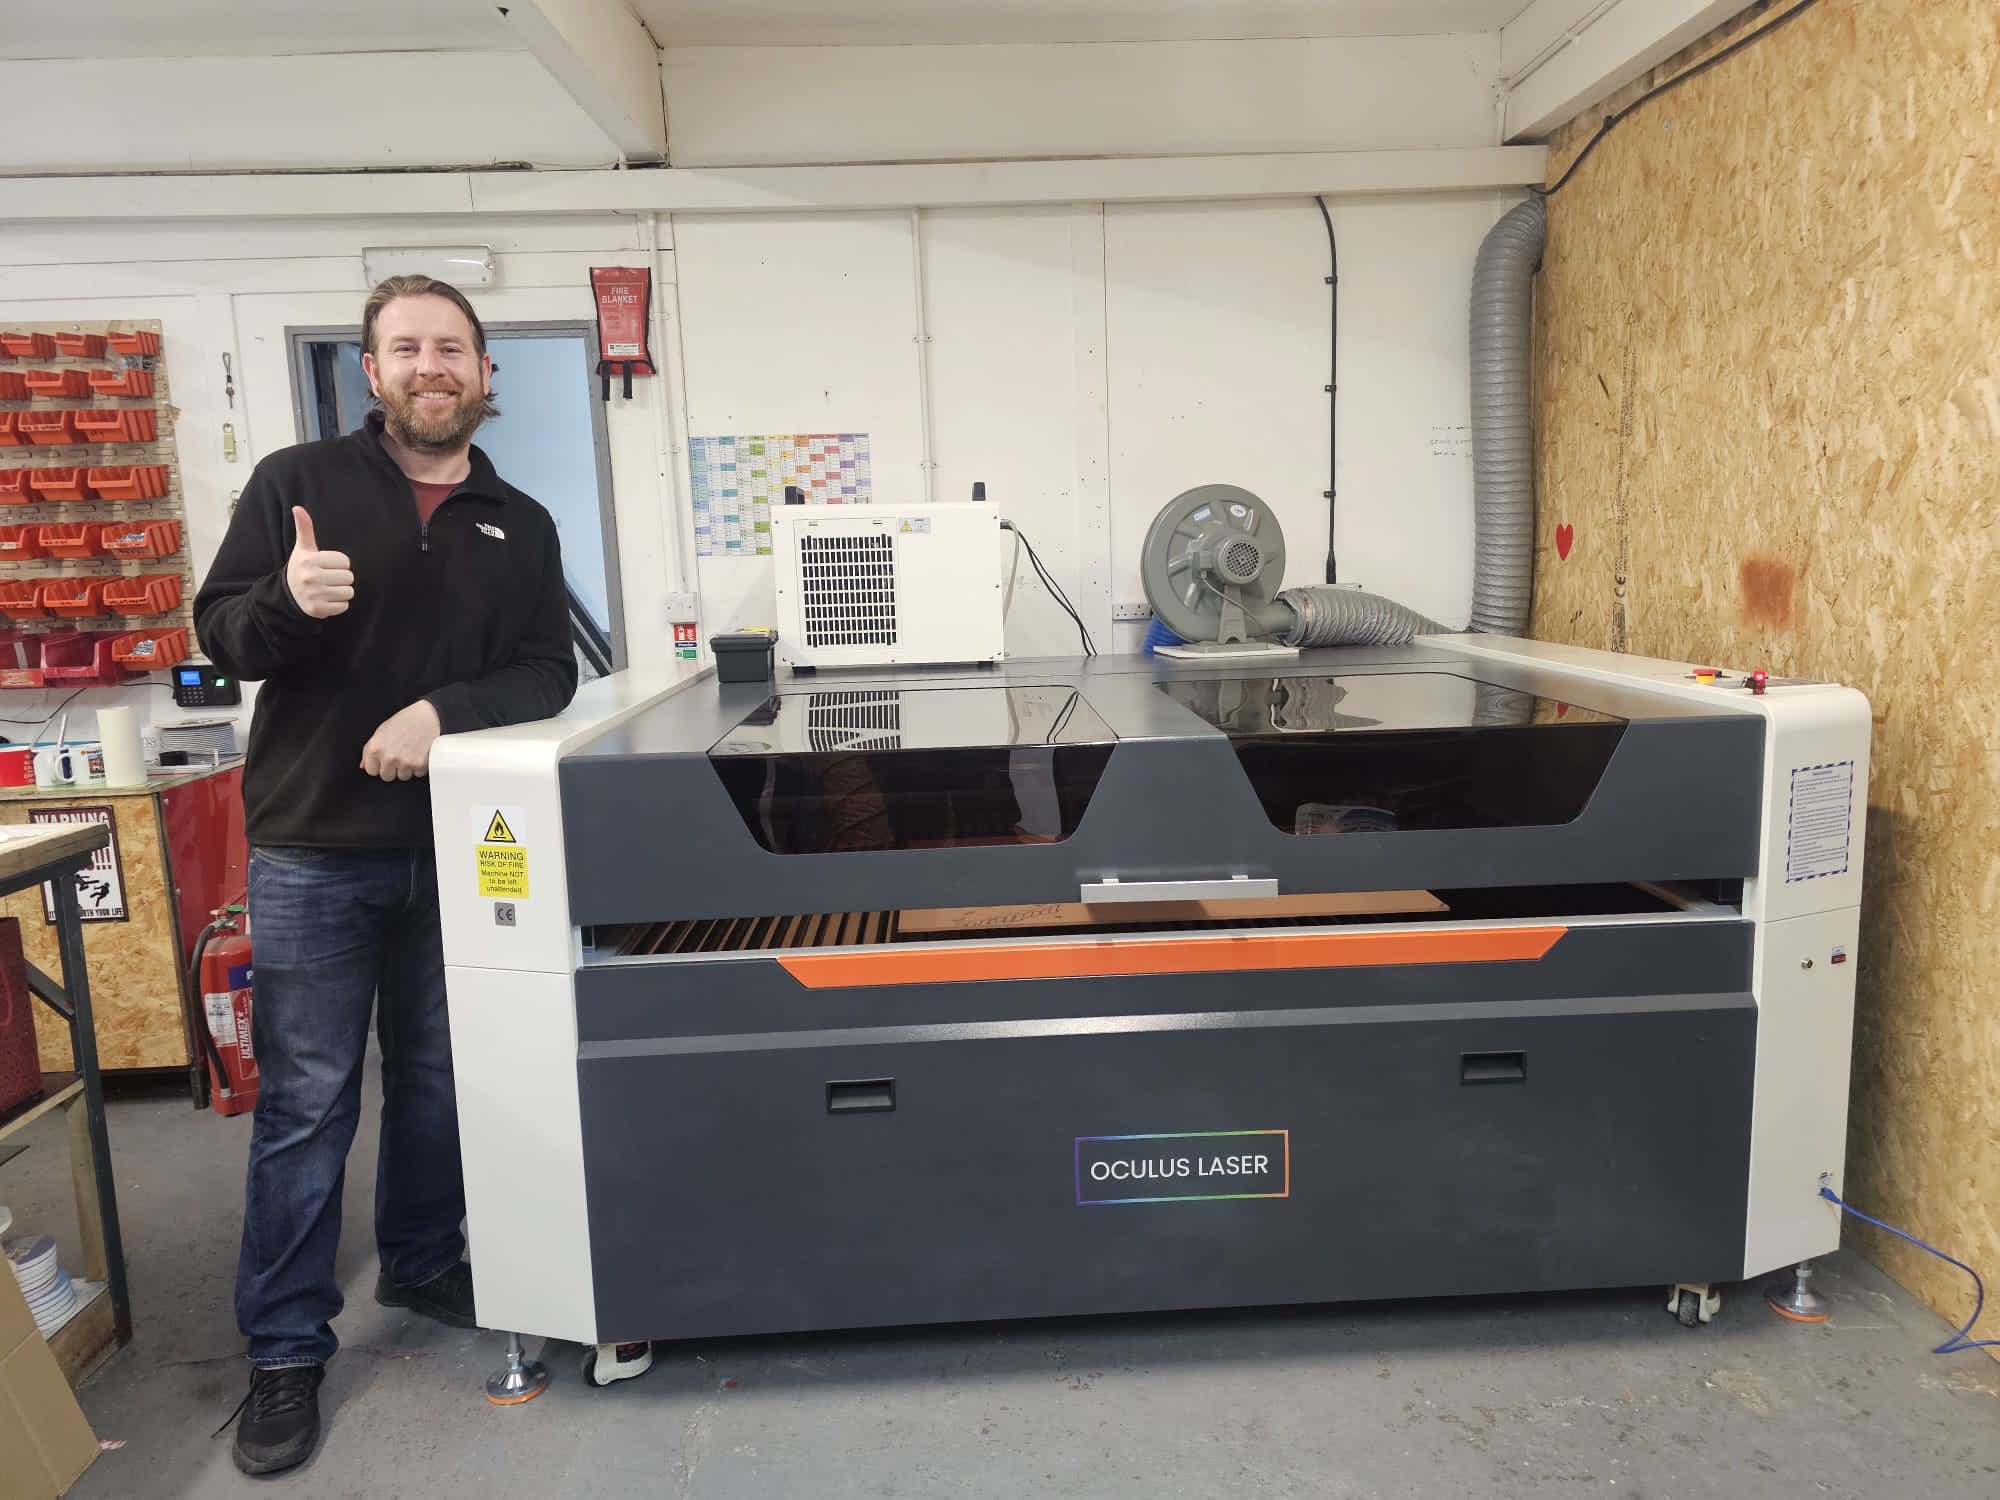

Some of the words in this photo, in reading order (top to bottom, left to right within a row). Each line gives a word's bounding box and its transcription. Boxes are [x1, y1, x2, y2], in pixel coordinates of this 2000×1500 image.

[611, 287, 630, 295] FIRE
[480, 851, 524, 861] WARNING
[111, 907, 123, 916] LIFE
[497, 908, 513, 921] CE
[238, 1017, 252, 1059] ULTIMEX
[1090, 1157, 1190, 1181] OCULUS
[1198, 1154, 1269, 1177] LASER
